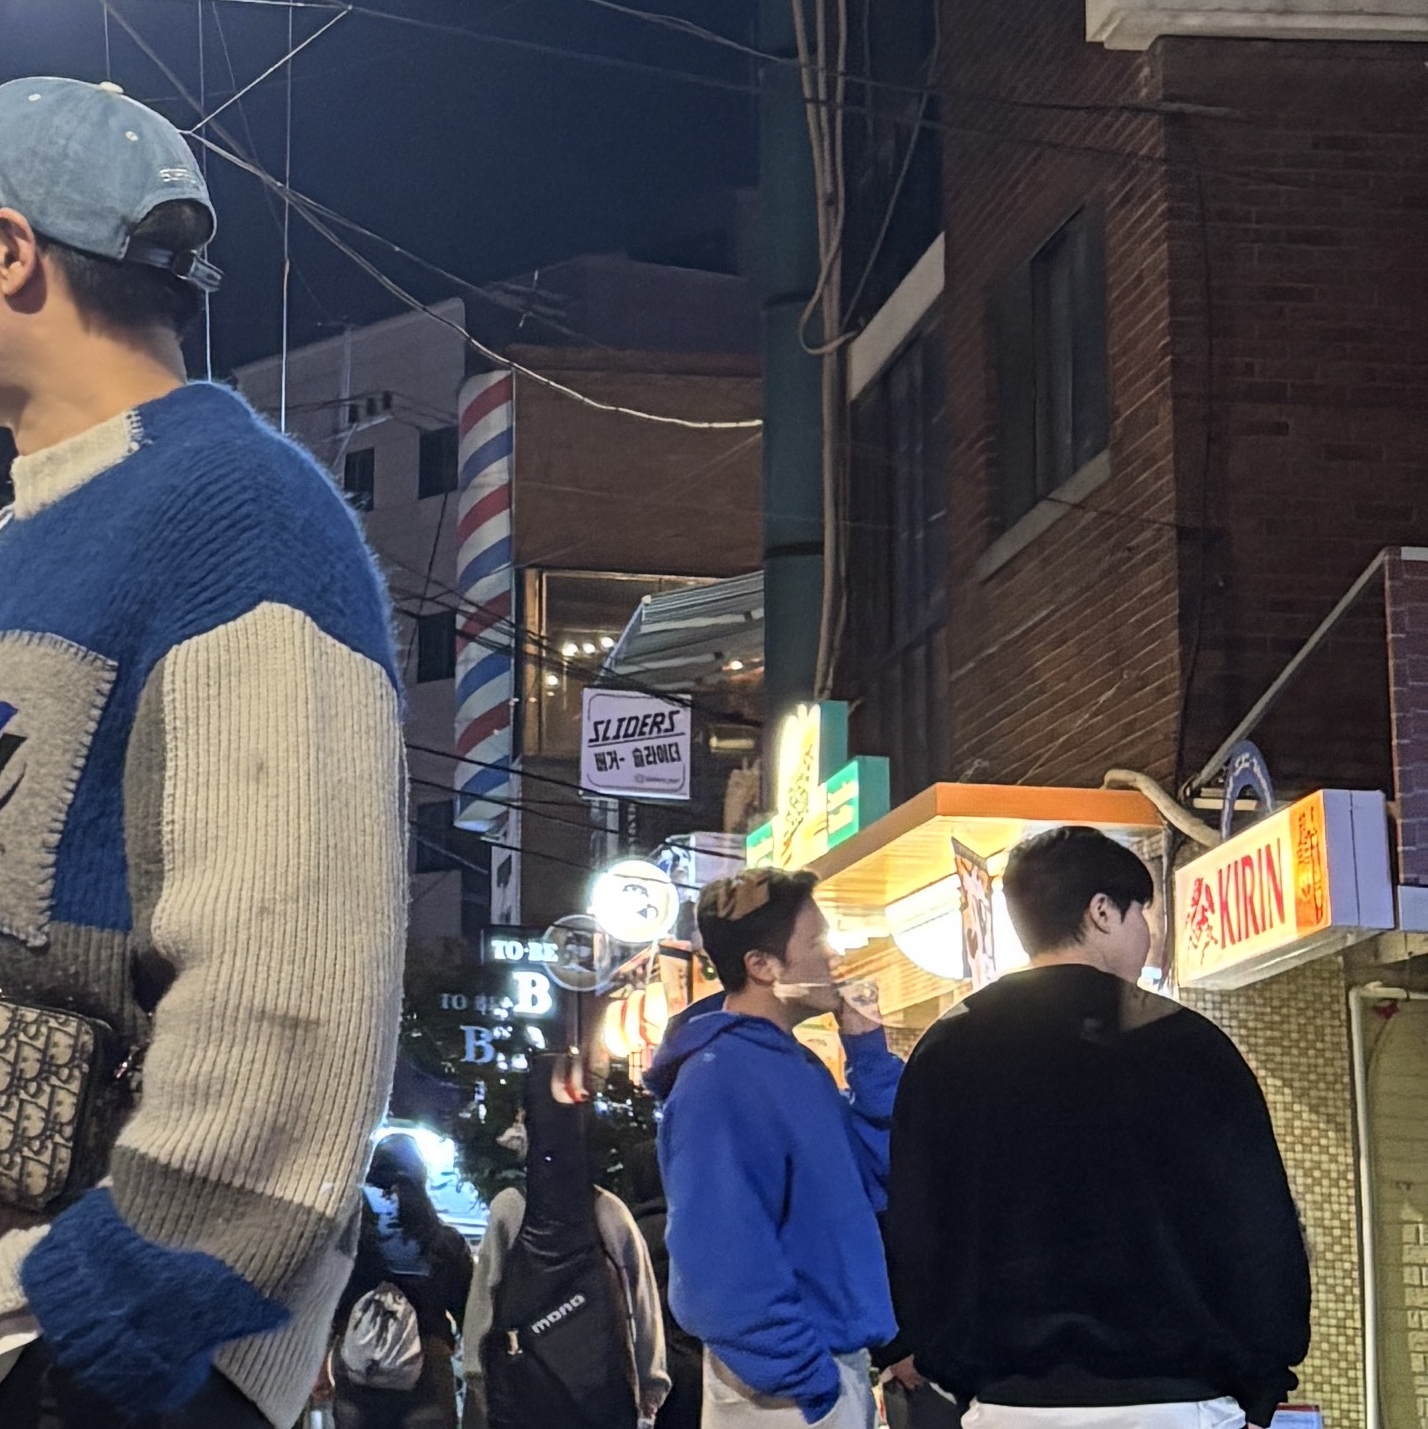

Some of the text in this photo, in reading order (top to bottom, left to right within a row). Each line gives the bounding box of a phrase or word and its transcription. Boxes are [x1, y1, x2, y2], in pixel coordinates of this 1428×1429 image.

[587, 709, 682, 744] SLIDERS
[1218, 837, 1286, 951] KIRIN
[511, 970, 554, 1015] B
